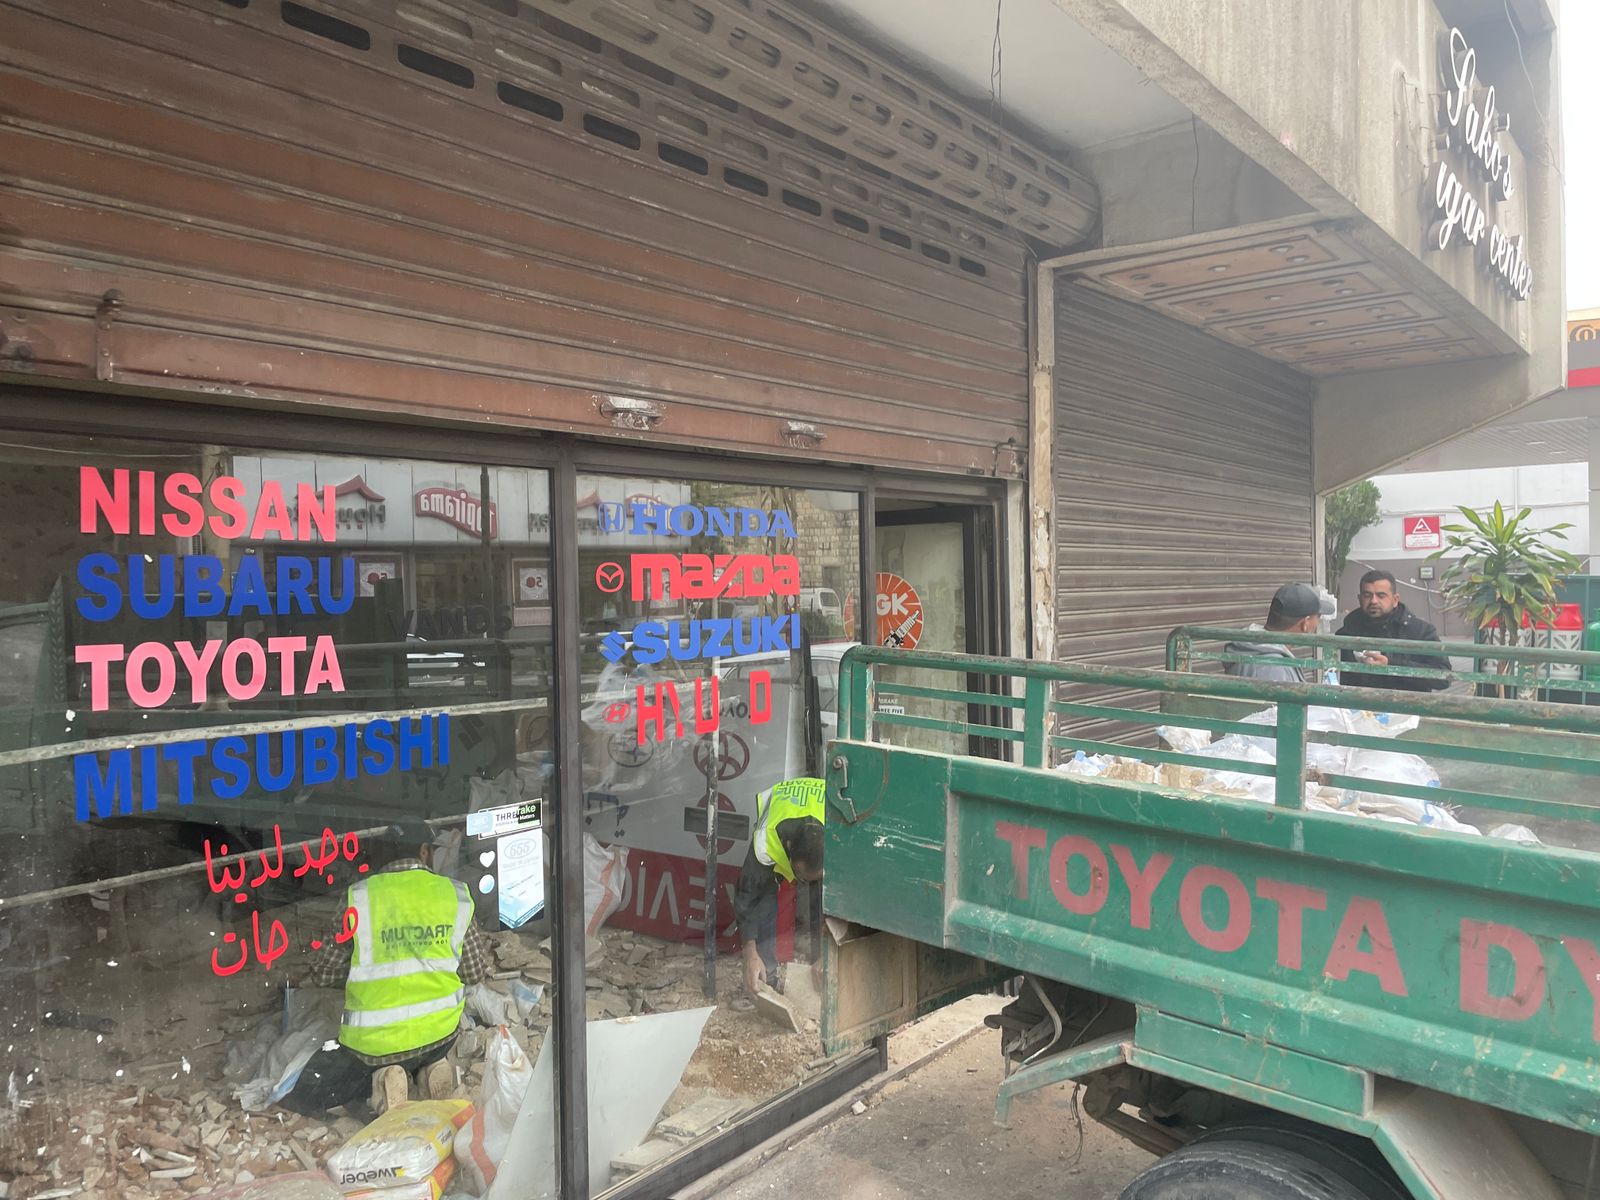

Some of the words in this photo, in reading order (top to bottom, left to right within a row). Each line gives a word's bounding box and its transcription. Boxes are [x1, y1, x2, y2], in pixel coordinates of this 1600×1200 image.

[79, 465, 337, 543] NISSAN
[629, 502, 798, 538] HONDA
[76, 553, 356, 622] SUBARU
[74, 635, 346, 712] TOYOTA
[632, 613, 801, 665] SUZUKI
[74, 713, 450, 823] MITSUBISHI
[995, 820, 1409, 998] TOYOTA
[339, 1167, 393, 1186] weber
